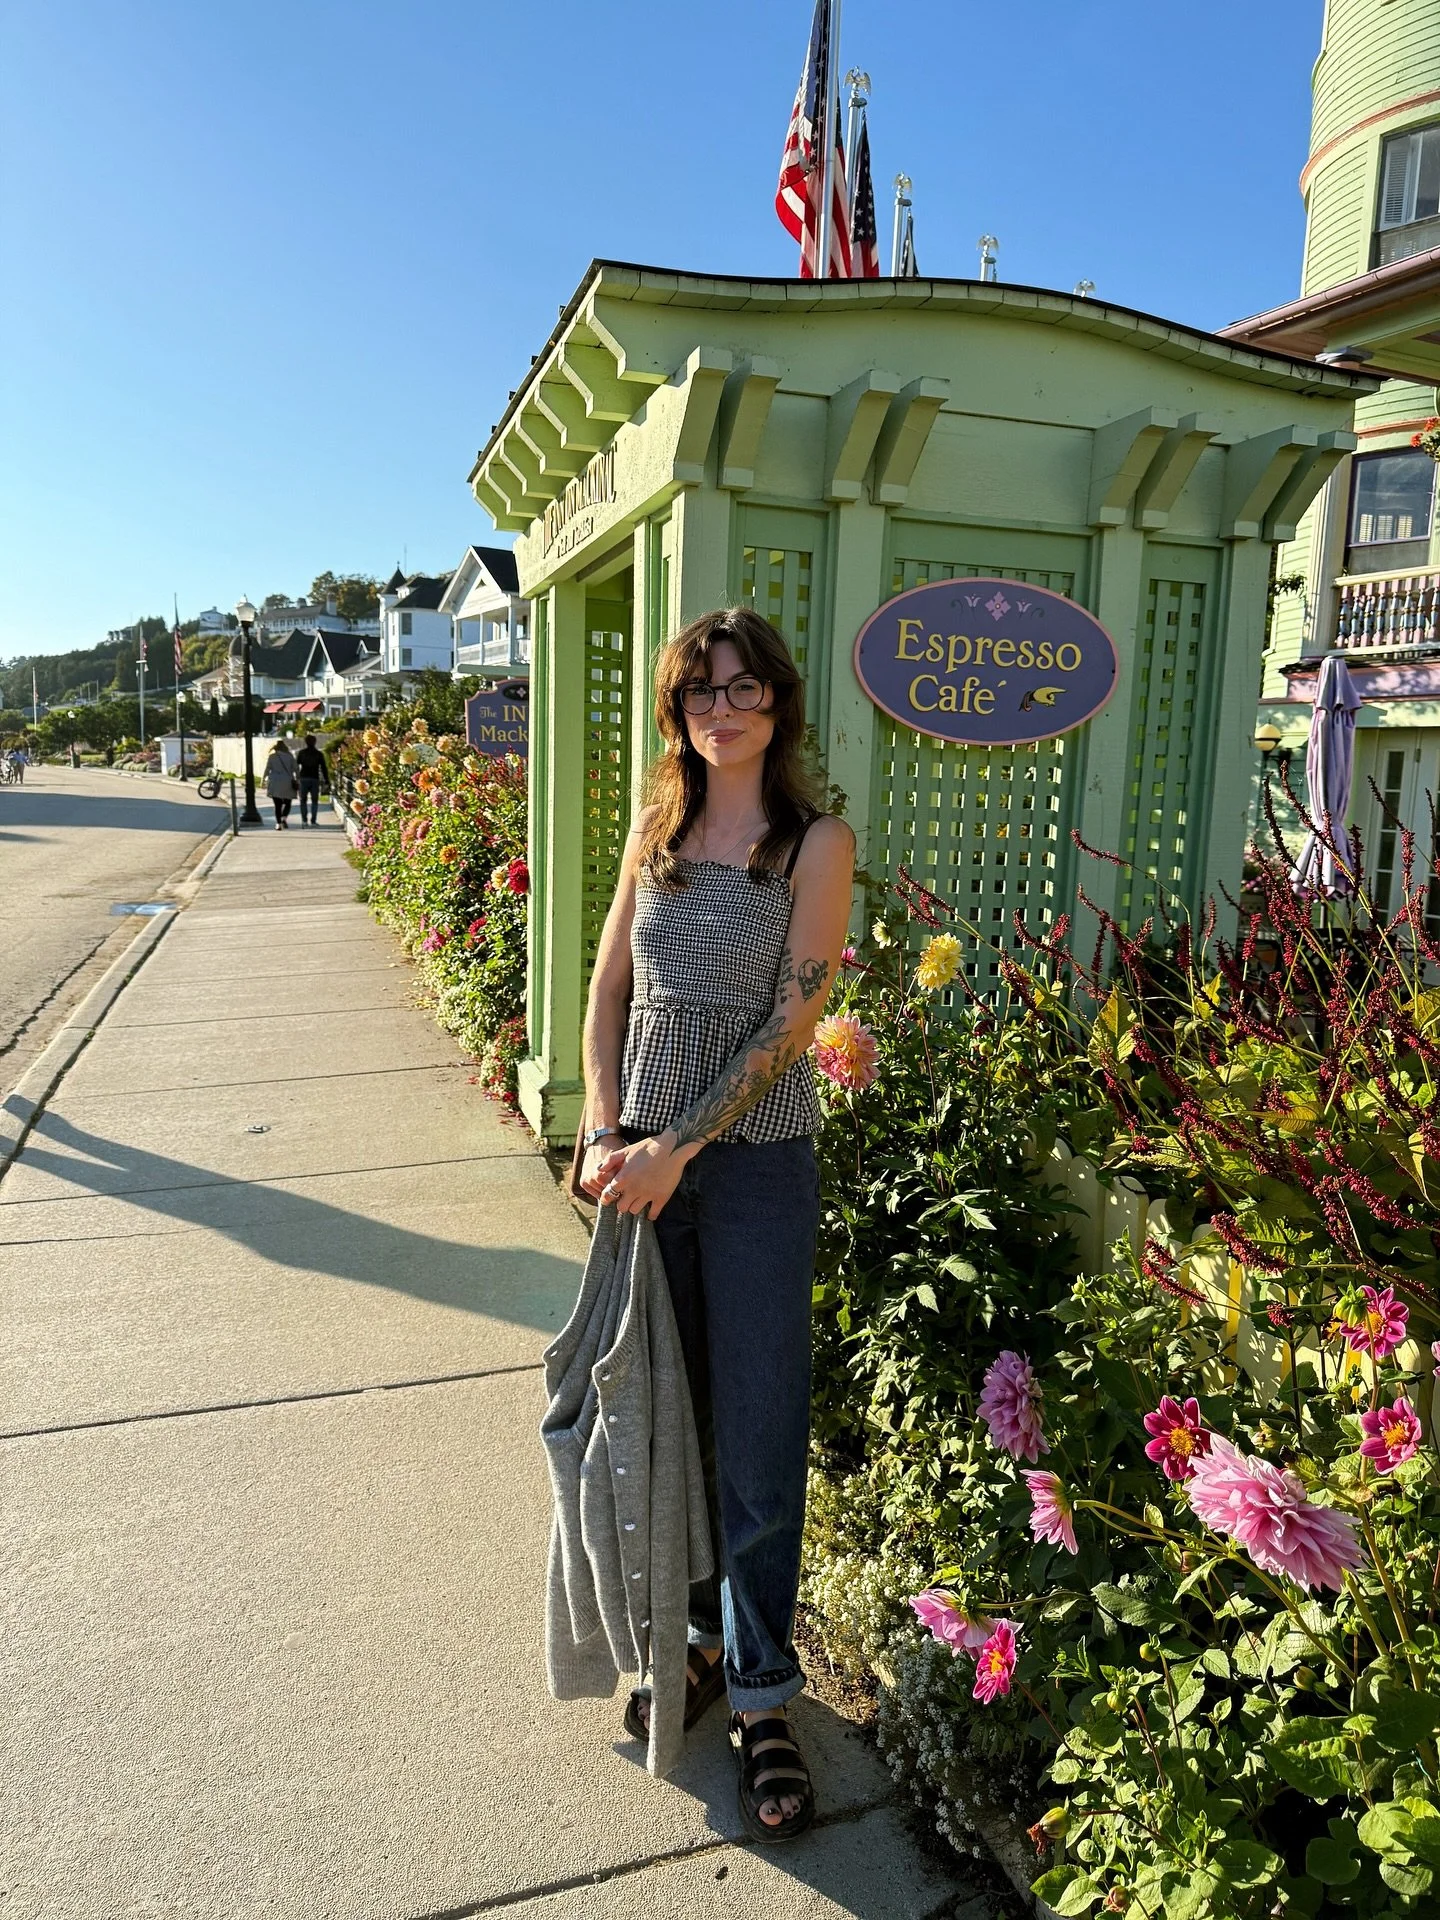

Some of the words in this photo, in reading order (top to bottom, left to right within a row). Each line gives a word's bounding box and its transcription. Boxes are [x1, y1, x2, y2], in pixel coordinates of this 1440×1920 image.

[894, 618, 1082, 673] Espresso
[908, 674, 1007, 715] Café
[480, 706, 497, 718] The
[480, 725, 528, 742] Mack
